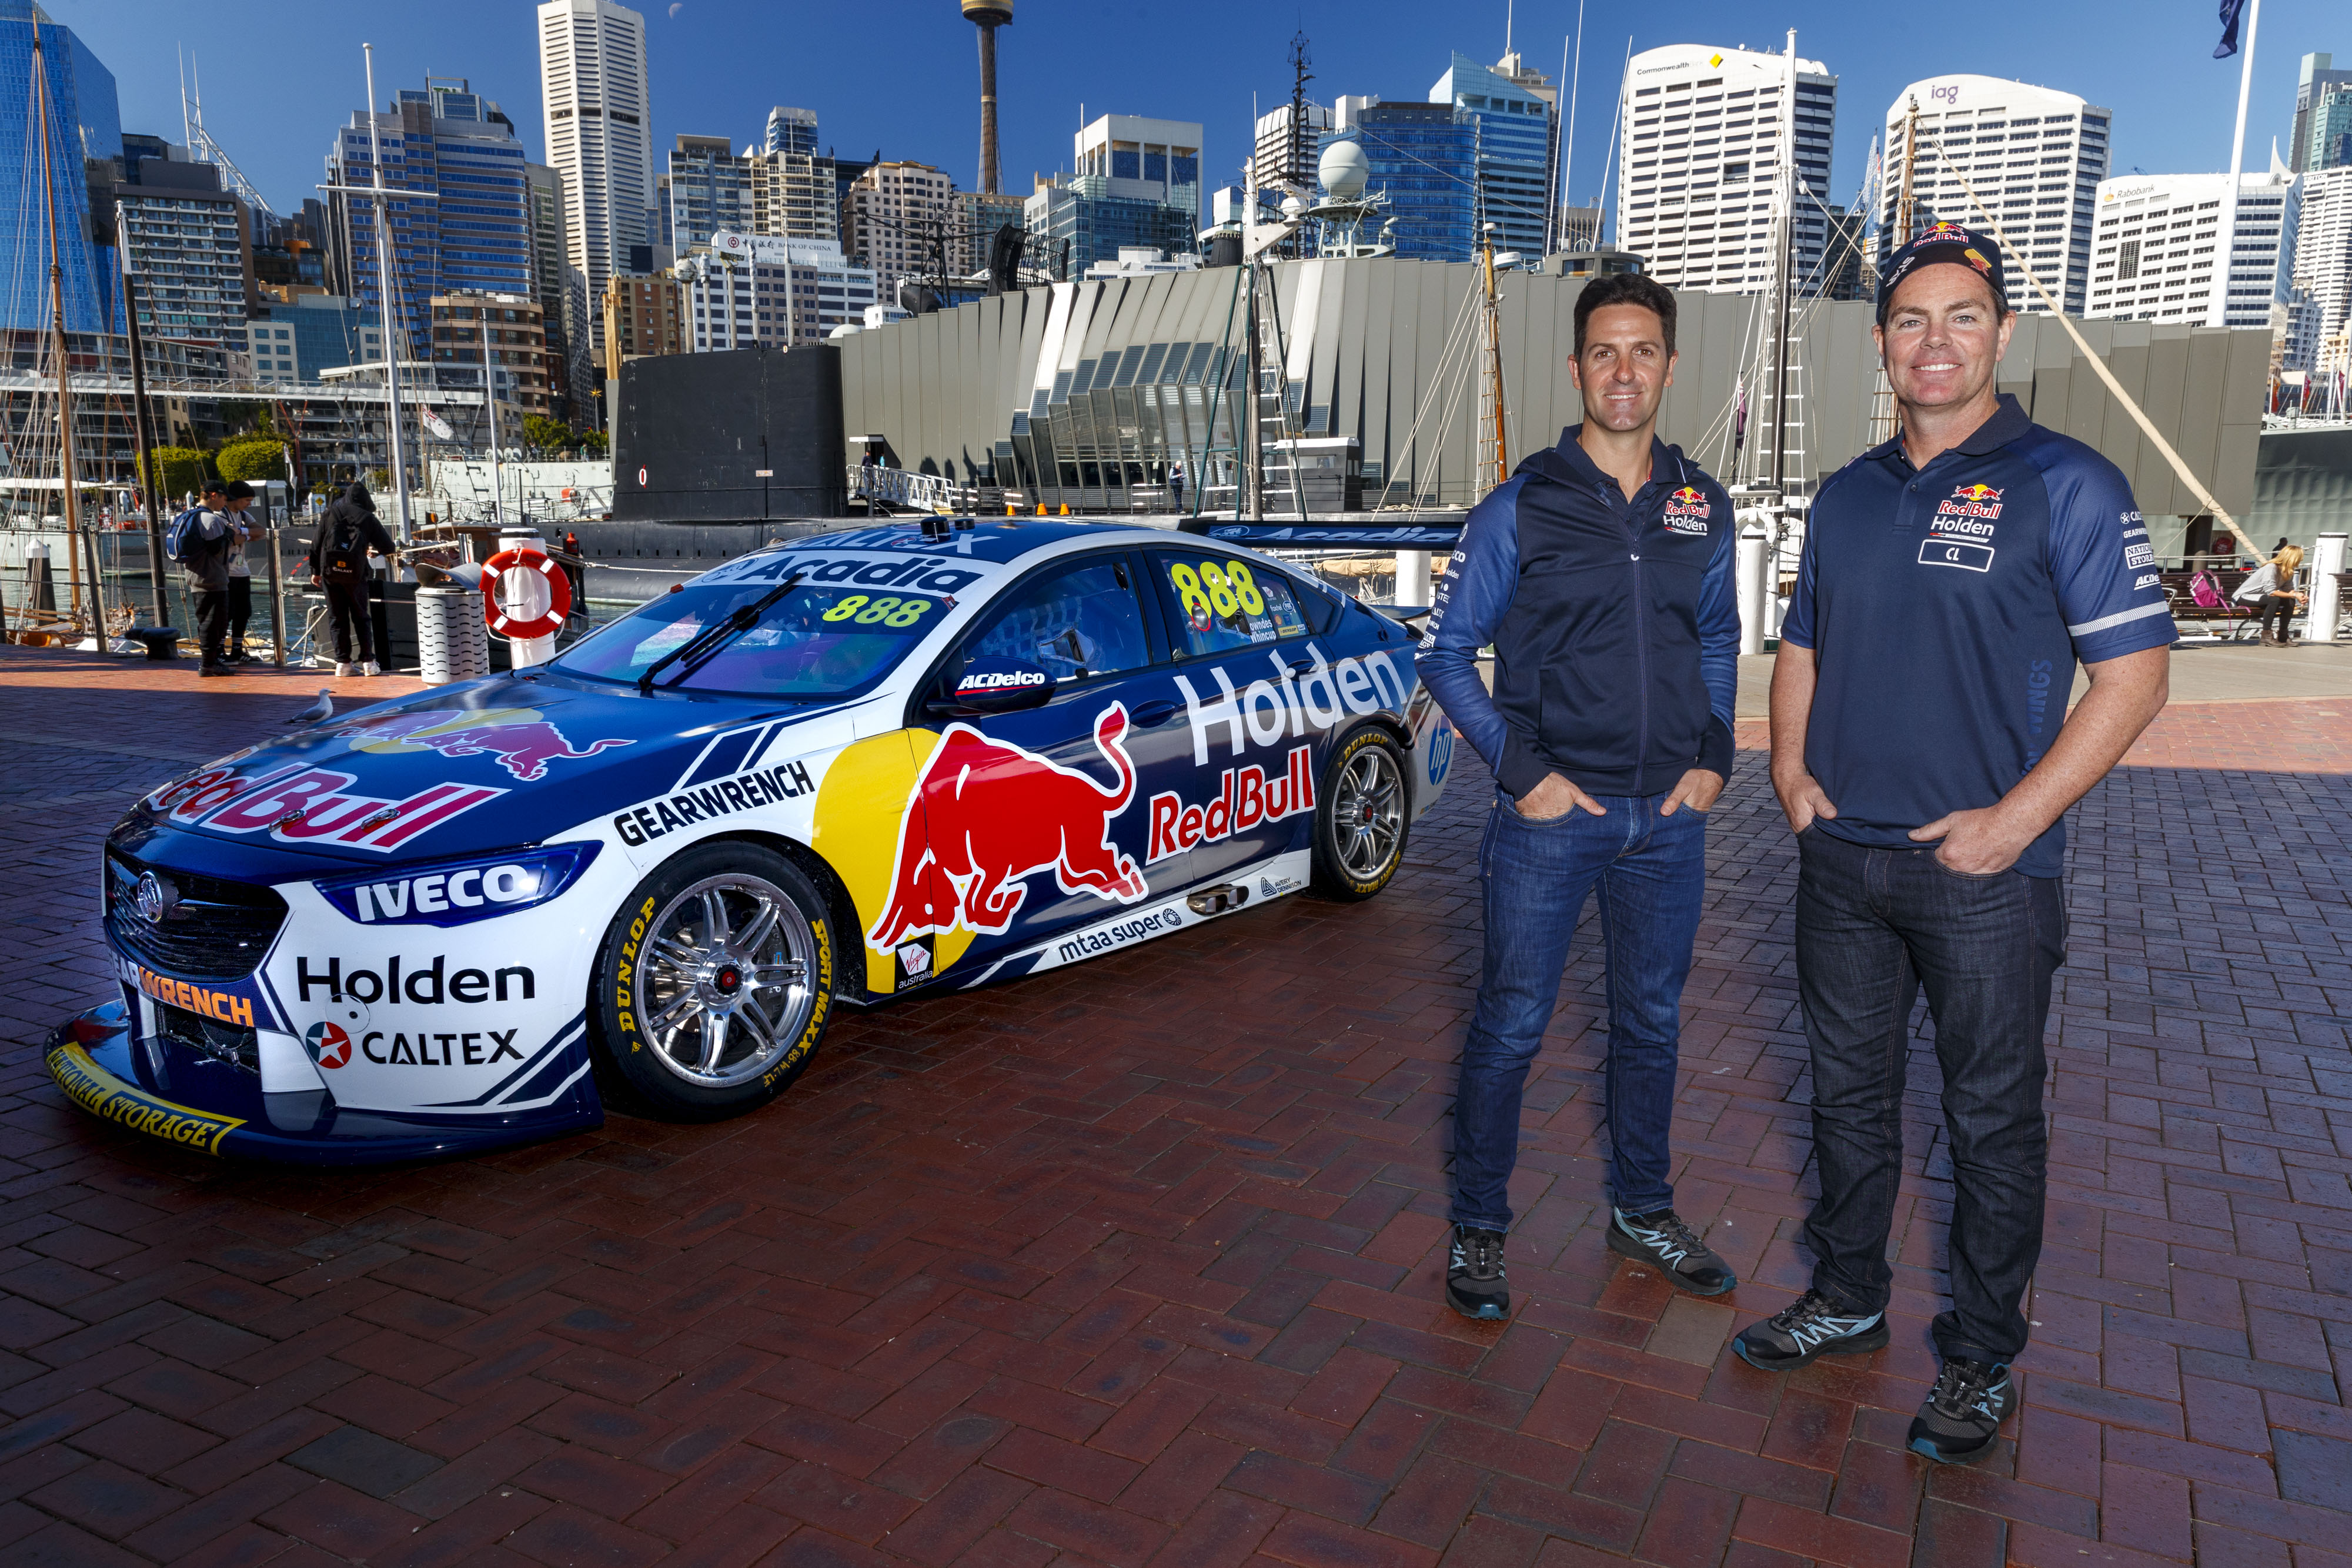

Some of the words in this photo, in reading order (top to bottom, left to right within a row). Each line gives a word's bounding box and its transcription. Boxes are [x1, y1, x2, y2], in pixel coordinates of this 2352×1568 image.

[1637, 62, 1689, 75] Commonwealth
[1932, 85, 1959, 104] iag
[2117, 184, 2155, 199] Rabobank
[1663, 515, 1708, 531] Holden
[1665, 500, 1689, 516] Red
[1688, 503, 1710, 519] Bull
[1937, 500, 1972, 516] Red
[1968, 502, 2003, 520] Bull
[1246, 526, 1459, 541] Acadia
[1930, 516, 1994, 536] Holden
[1946, 547, 1960, 561] CL
[734, 555, 984, 594] Acadia
[1171, 560, 1264, 618] 888
[822, 596, 931, 627] 888
[1270, 603, 1282, 611] foxtel
[1250, 630, 1277, 643] Whincup
[957, 670, 1045, 690] ACDelco
[1174, 643, 1406, 765] Holden
[2027, 659, 2053, 735] WINGS
[1344, 733, 1388, 761] DUNLOP
[1431, 718, 1451, 785] hp
[200, 768, 512, 853] Bull
[614, 761, 815, 847] GEARWRENCH
[1147, 768, 1237, 866] Red
[1234, 743, 1316, 834] Bull
[355, 864, 527, 922] IVECO
[1275, 877, 1291, 887] AVERY
[1277, 880, 1302, 893] DENNISON
[1058, 934, 1114, 962] mtaa
[1111, 914, 1164, 940] super
[617, 897, 656, 1032] DUNLOP
[811, 918, 831, 990] SPORT
[906, 948, 926, 972] Virgin
[109, 948, 255, 1027] EARWRENCH
[298, 955, 535, 1004] Holden
[898, 970, 933, 989] australia
[798, 990, 830, 1057] MAXX
[362, 1028, 525, 1066] CALTEX
[103, 1095, 220, 1147] STORAGE
